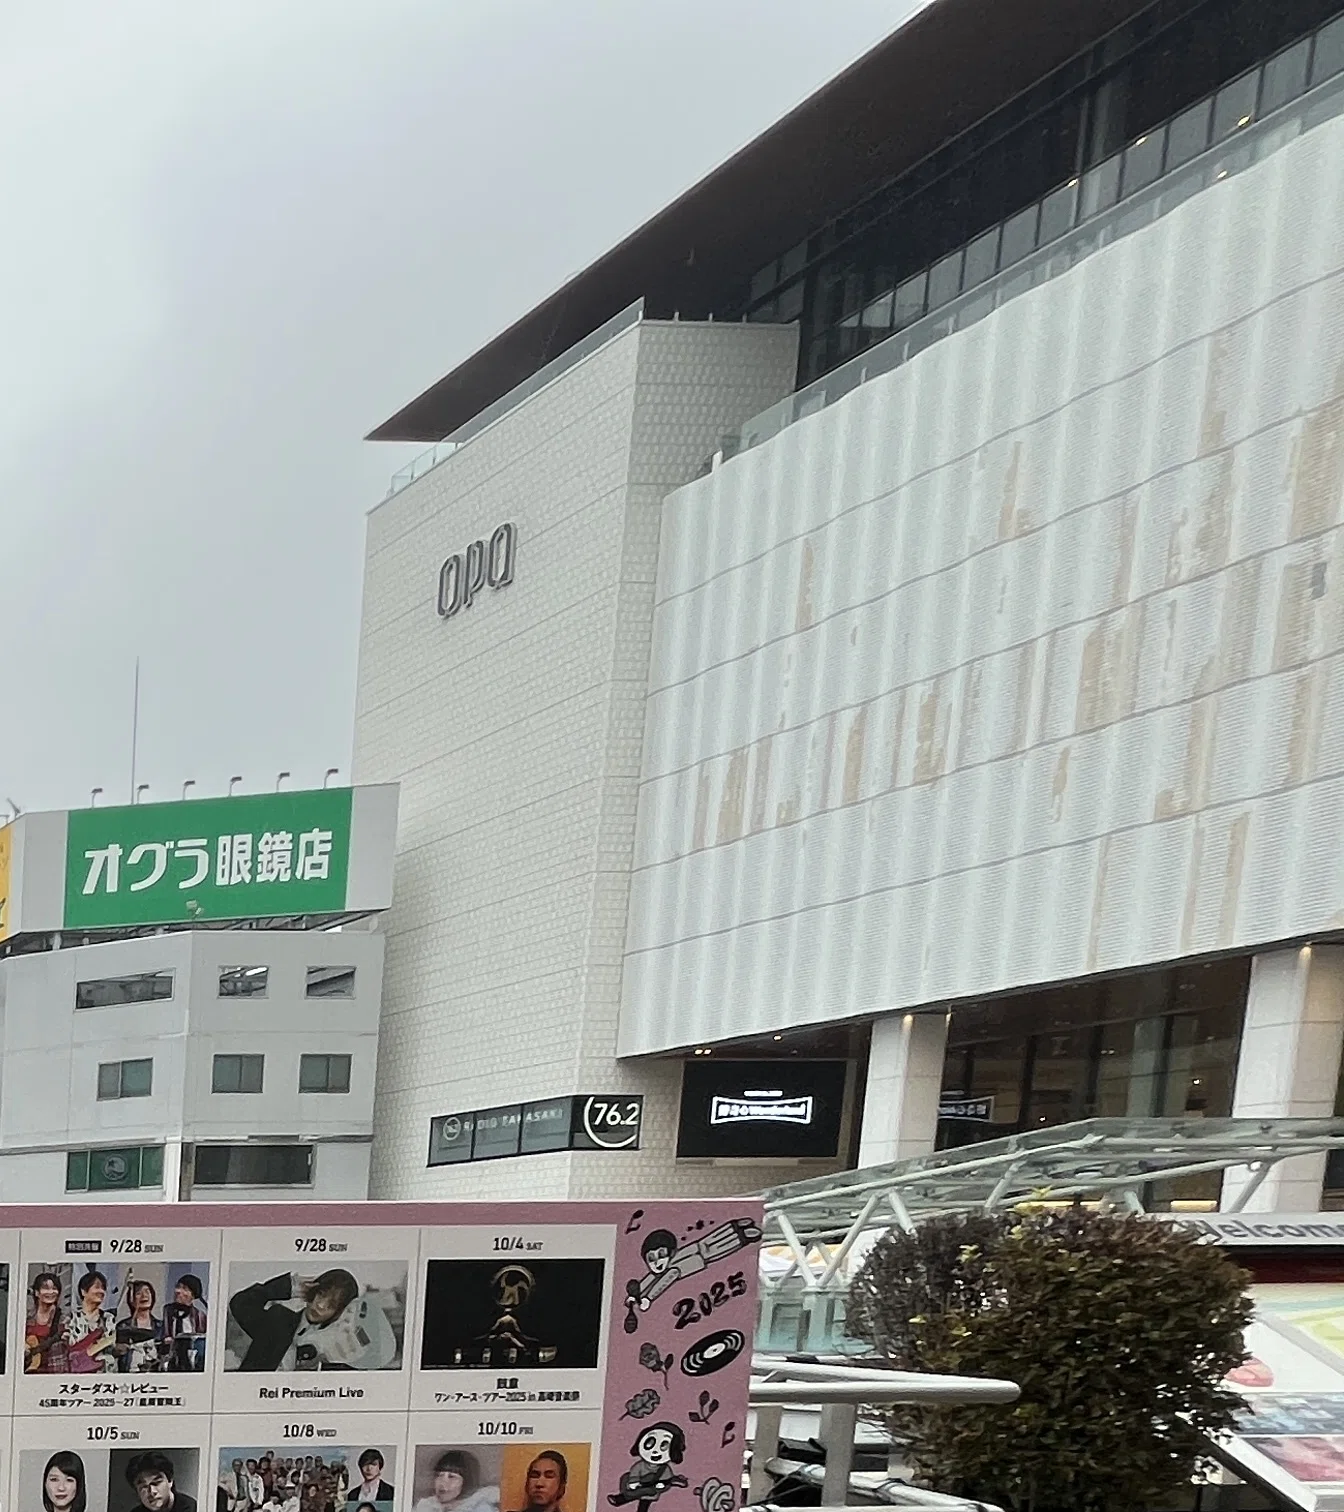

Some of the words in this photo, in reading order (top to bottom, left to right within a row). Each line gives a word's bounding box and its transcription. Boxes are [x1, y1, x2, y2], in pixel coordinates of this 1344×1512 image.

[81, 826, 334, 895] オグラ眼鏡店
[593, 1102, 639, 1126] 76.2
[110, 1239, 145, 1253] 9/28
[295, 1238, 326, 1252] 9/28
[493, 1237, 524, 1250] 10/4
[673, 1271, 748, 1331] 2025
[259, 1387, 278, 1398] Rei
[282, 1387, 335, 1398] Premium
[339, 1387, 364, 1397] Live
[87, 1426, 121, 1440] 10/5
[283, 1424, 314, 1438] 10/8
[478, 1421, 519, 1435] 10/10
